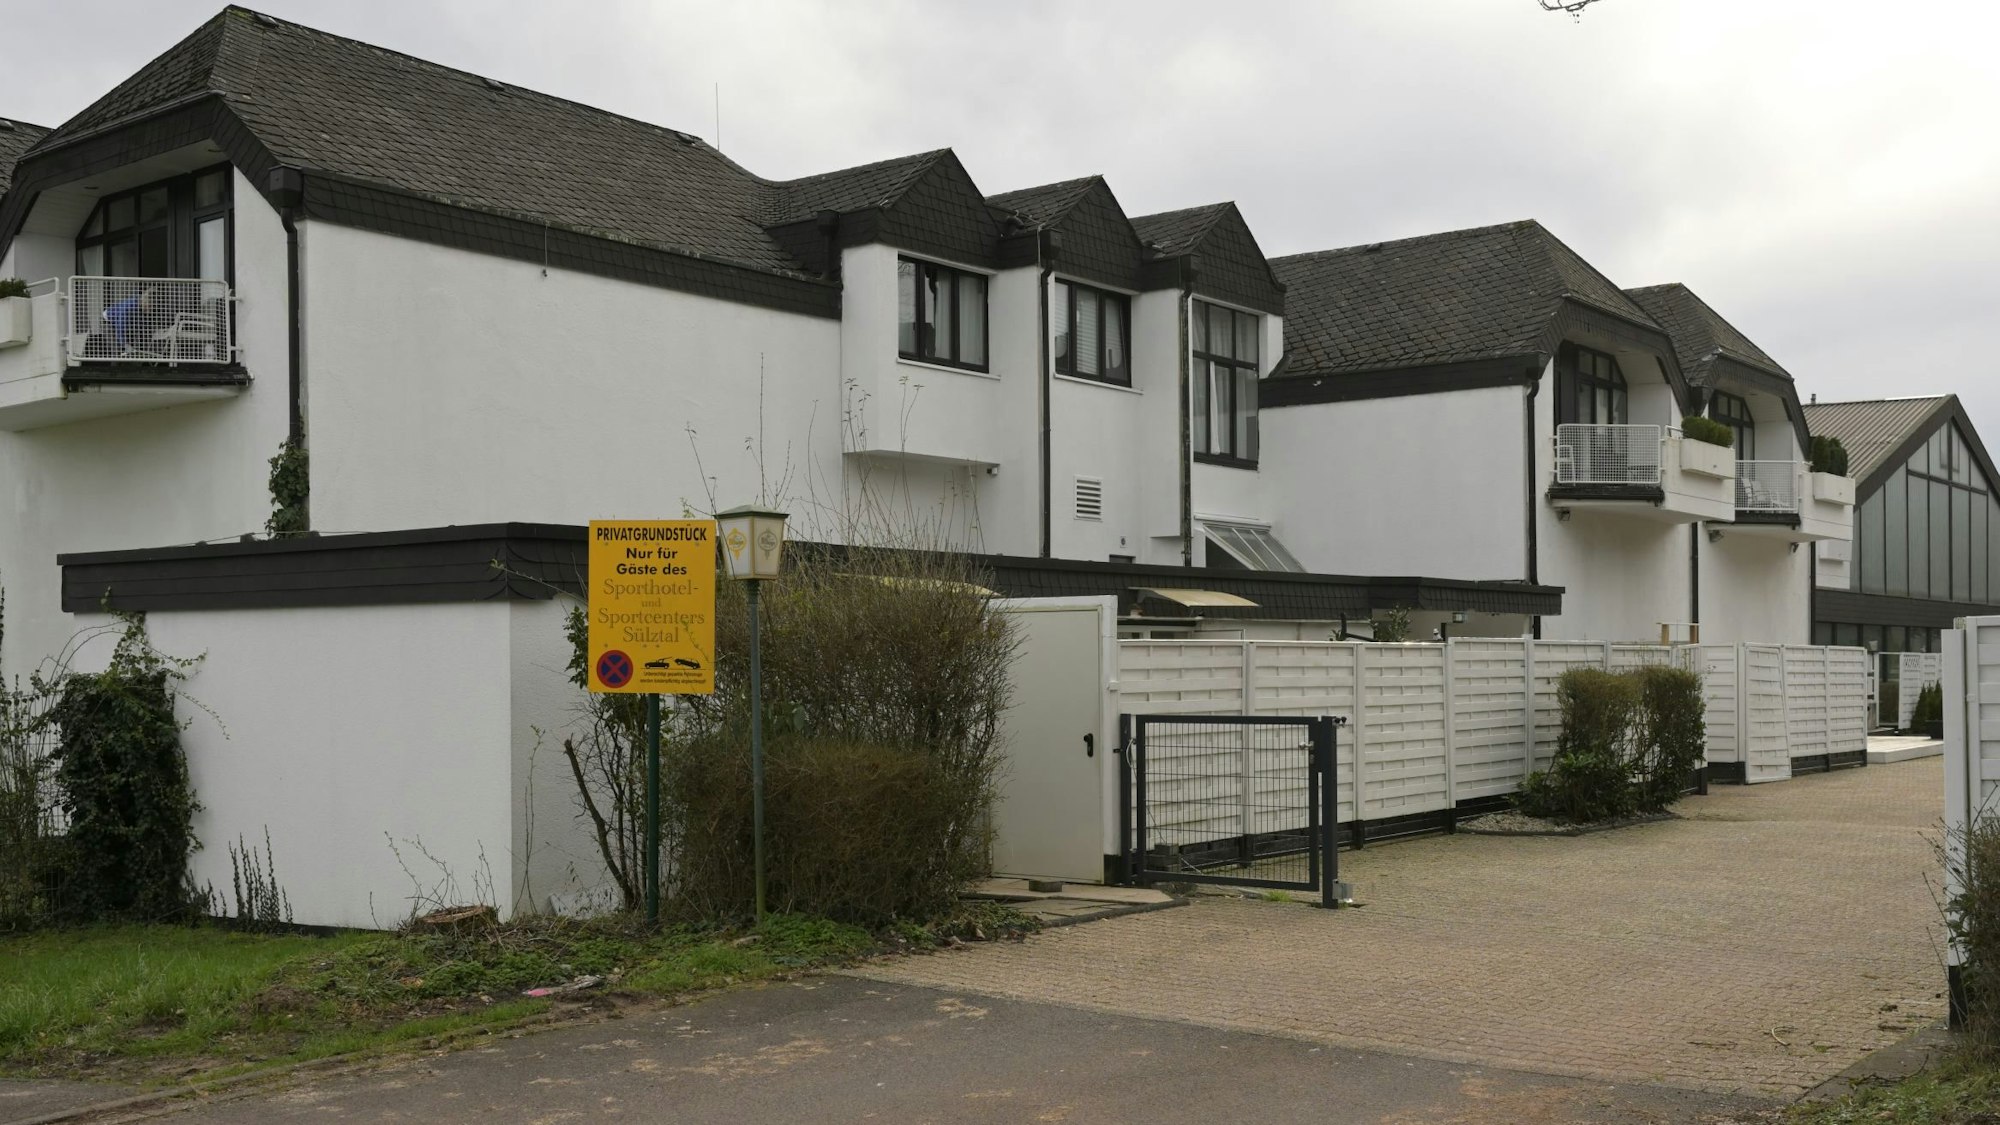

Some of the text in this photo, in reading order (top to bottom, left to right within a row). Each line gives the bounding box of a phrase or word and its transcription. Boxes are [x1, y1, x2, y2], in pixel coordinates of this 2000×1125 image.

[597, 523, 707, 541] PRIVATGRUNDSTÜCK
[626, 546, 678, 559] Nur für
[616, 563, 687, 575] Gäste des
[603, 578, 699, 600] Sporthotel-
[641, 598, 662, 608] und
[598, 607, 705, 629] Sportcenters
[622, 626, 680, 643] Sülztal
